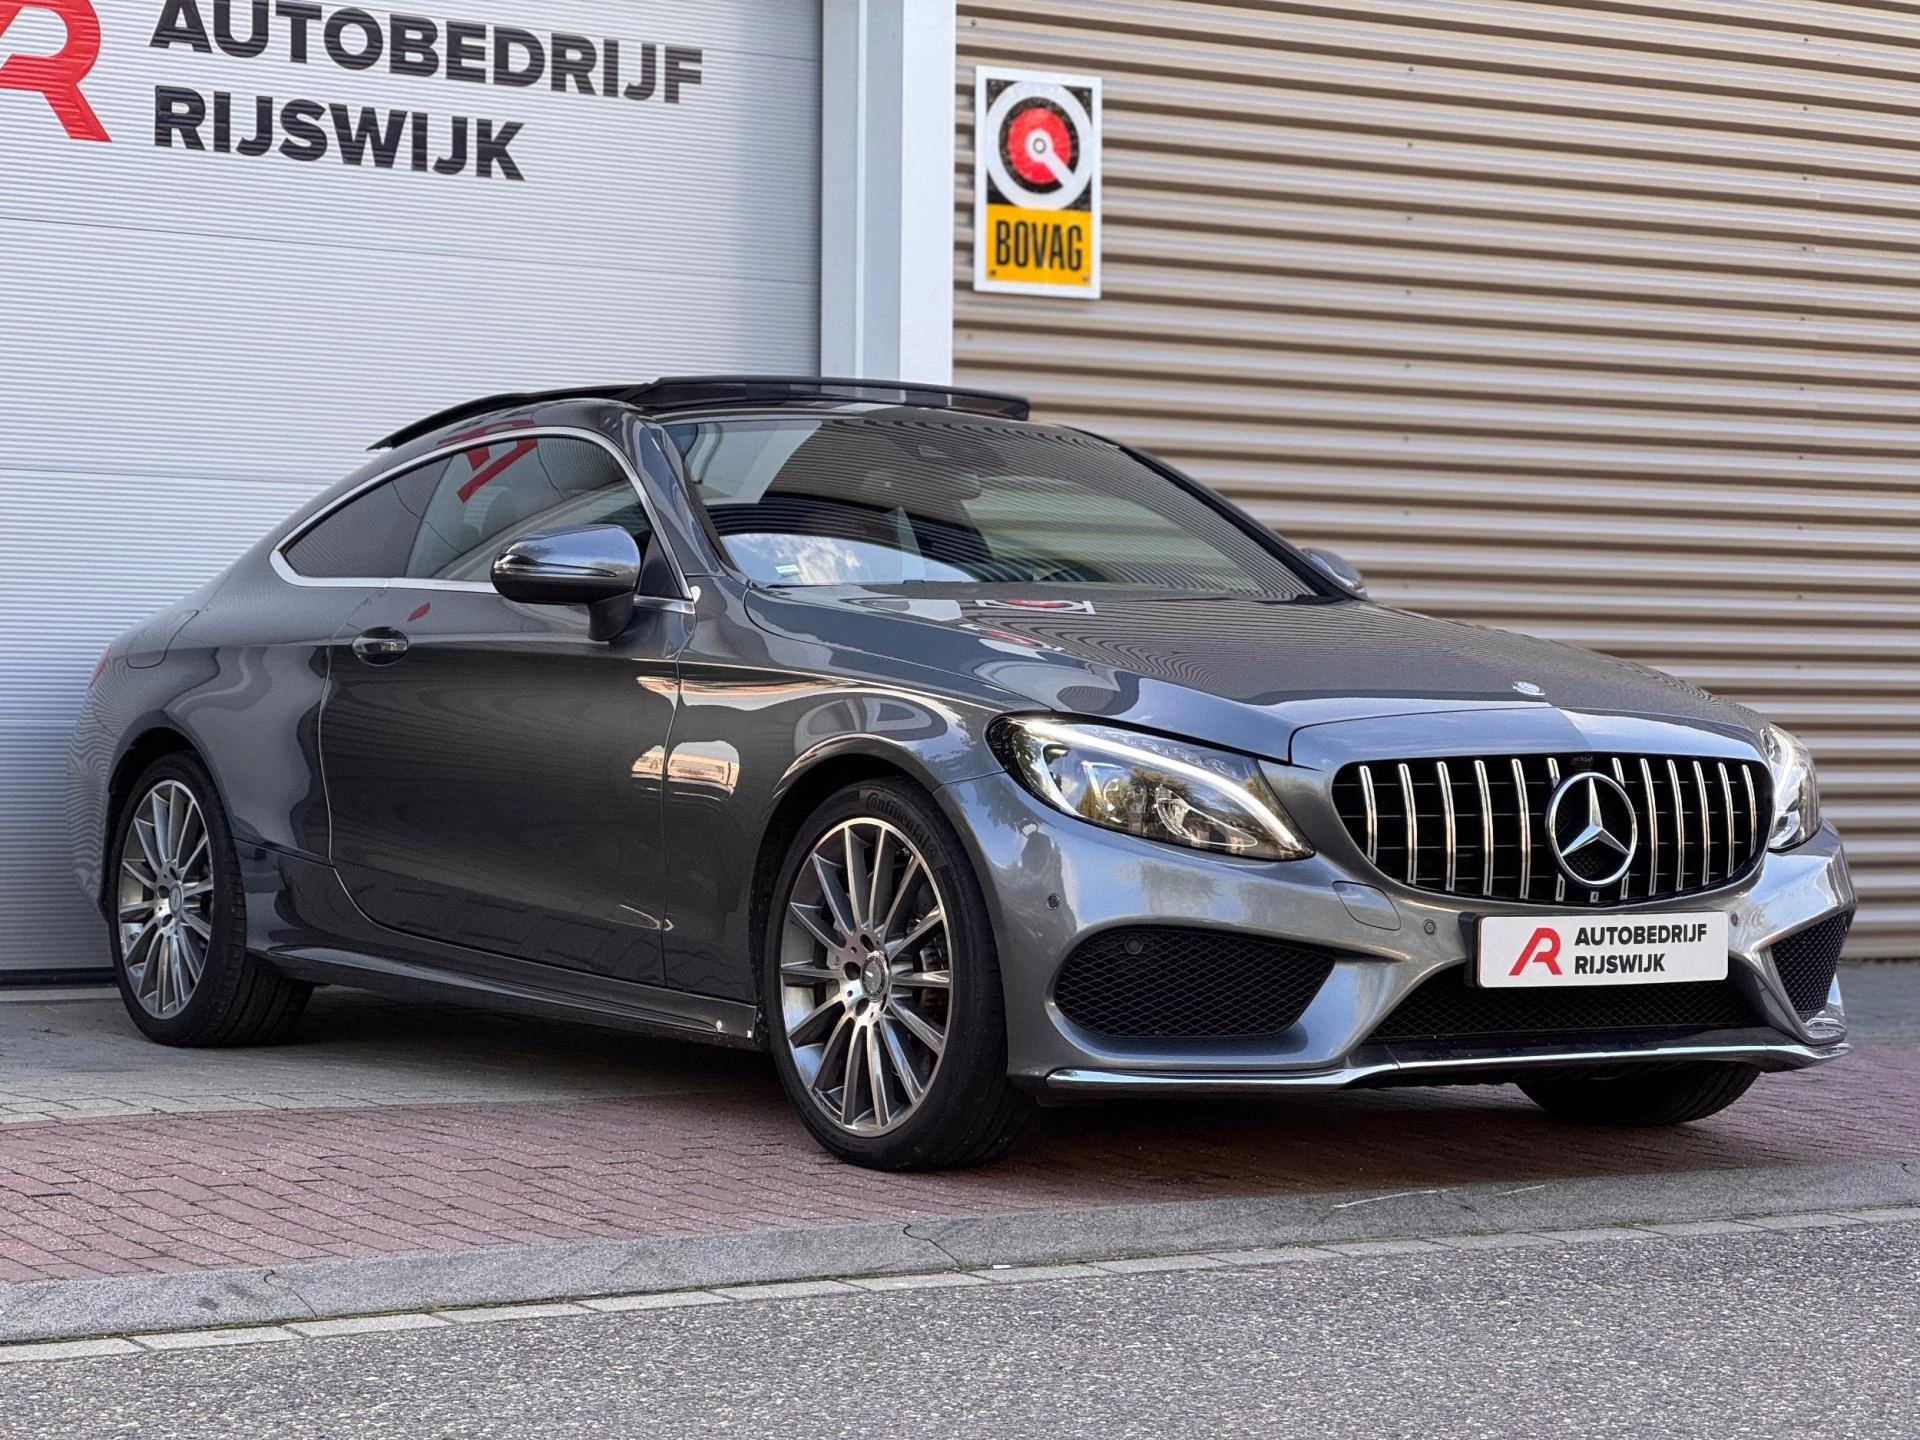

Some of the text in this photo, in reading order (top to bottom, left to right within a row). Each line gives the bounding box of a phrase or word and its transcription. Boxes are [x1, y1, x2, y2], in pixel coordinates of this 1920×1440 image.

[149, 0, 703, 104] AUTOBEDRIJF
[153, 85, 526, 181] RIJSWIJK
[996, 220, 1082, 271] BOVAG
[1574, 924, 1707, 946] AUTOBEDRIJF
[1574, 953, 1665, 974] RIJSWIJK
